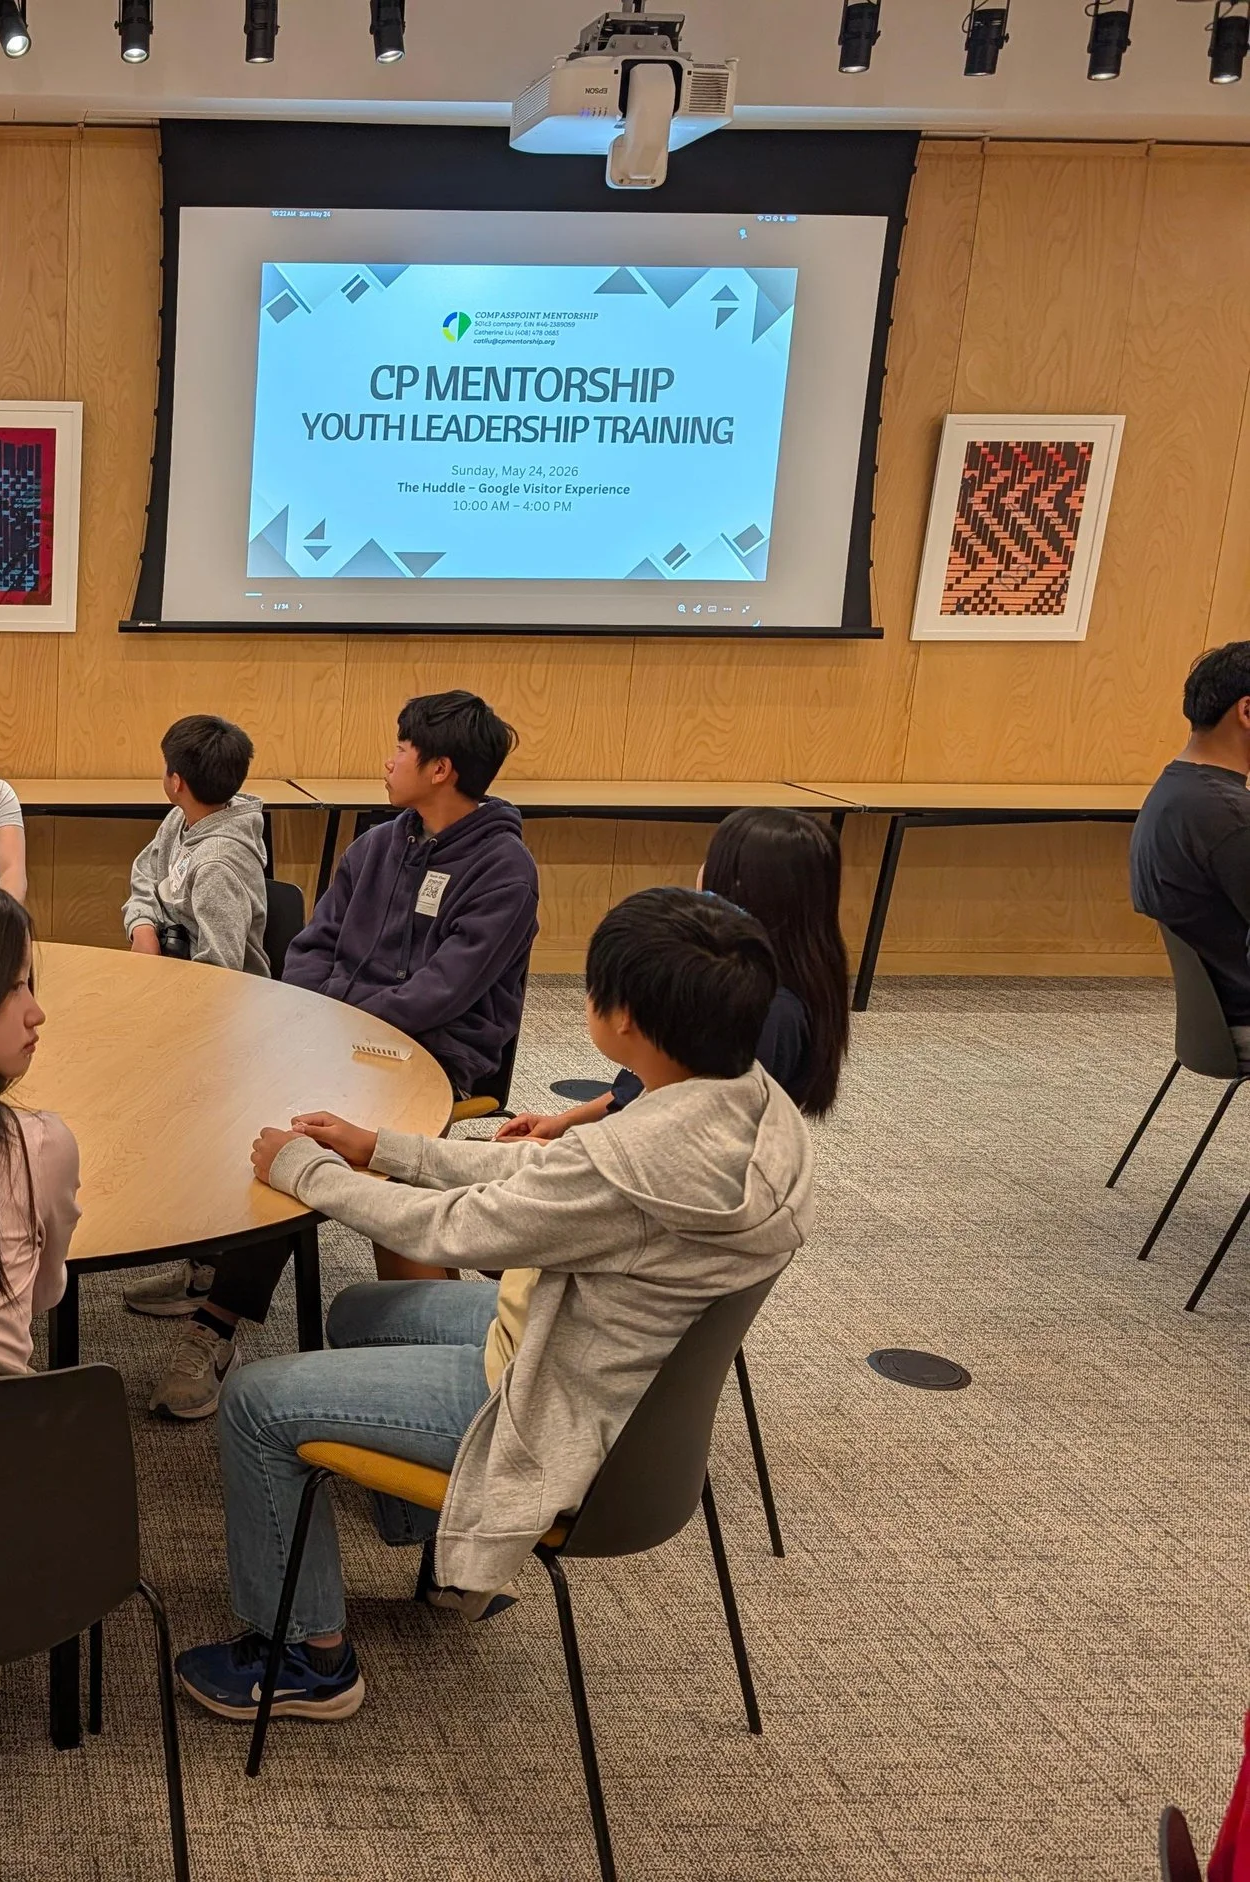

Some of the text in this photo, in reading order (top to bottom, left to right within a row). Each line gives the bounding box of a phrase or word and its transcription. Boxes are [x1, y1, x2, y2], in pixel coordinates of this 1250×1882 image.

[310, 210, 322, 218] May
[474, 311, 599, 320] COMPASSPOINT MENTORSHIP
[369, 364, 676, 403] CP MENTORSHIP
[301, 412, 734, 445] YOUTH LEADERSHIP TRAINING
[451, 464, 579, 479] Sunday, May 24, 2026
[397, 482, 420, 493] The
[422, 482, 466, 494] Huddle
[478, 482, 520, 497] Google
[523, 483, 562, 495] Visitor
[564, 483, 631, 497] Experience
[452, 500, 488, 512] 10:00
[490, 500, 510, 511] AM
[522, 500, 550, 512] 4:00
[553, 501, 572, 512] PM
